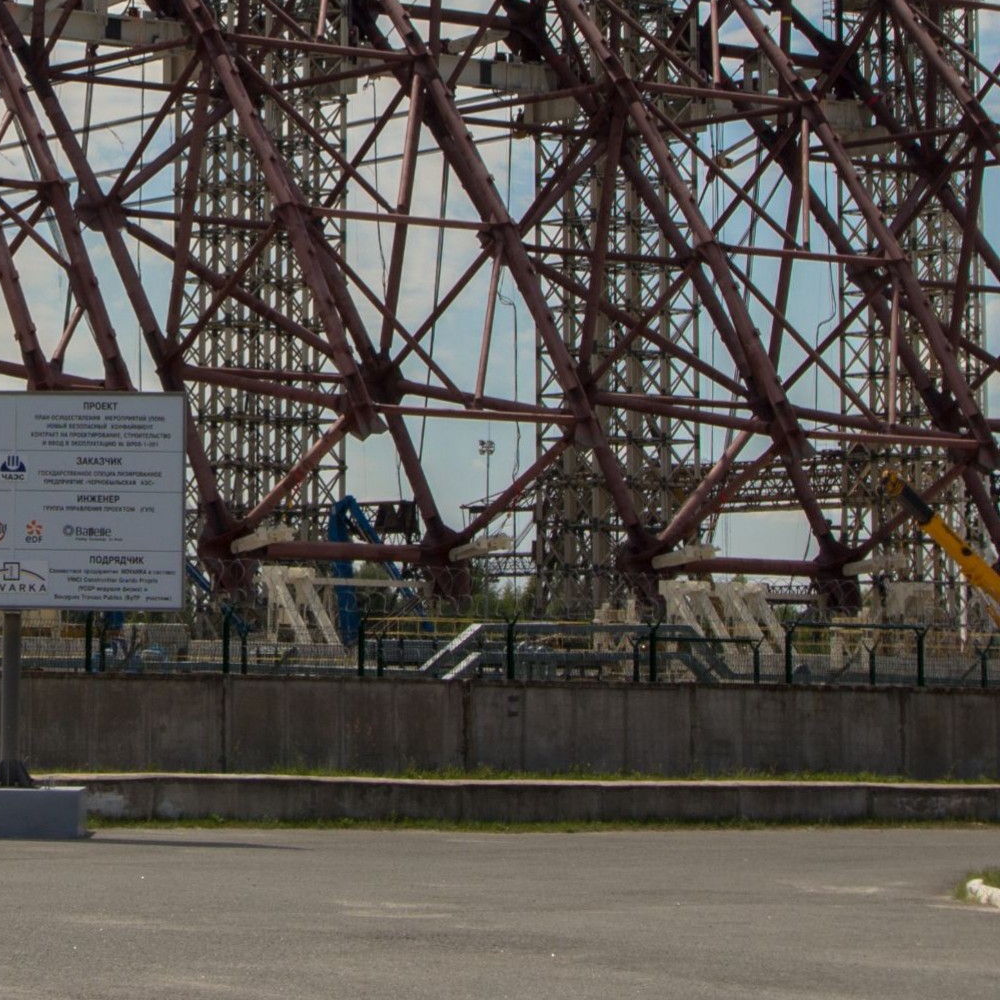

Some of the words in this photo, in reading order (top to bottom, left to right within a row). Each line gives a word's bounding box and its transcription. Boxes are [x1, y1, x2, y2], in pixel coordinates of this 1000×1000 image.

[83, 402, 118, 410] ПРОЕКТ
[76, 457, 123, 466] ЗАКАЗЧИК
[77, 495, 120, 503] ИНЖЕНЕР
[89, 555, 144, 565] ПОДРЯДЧИК
